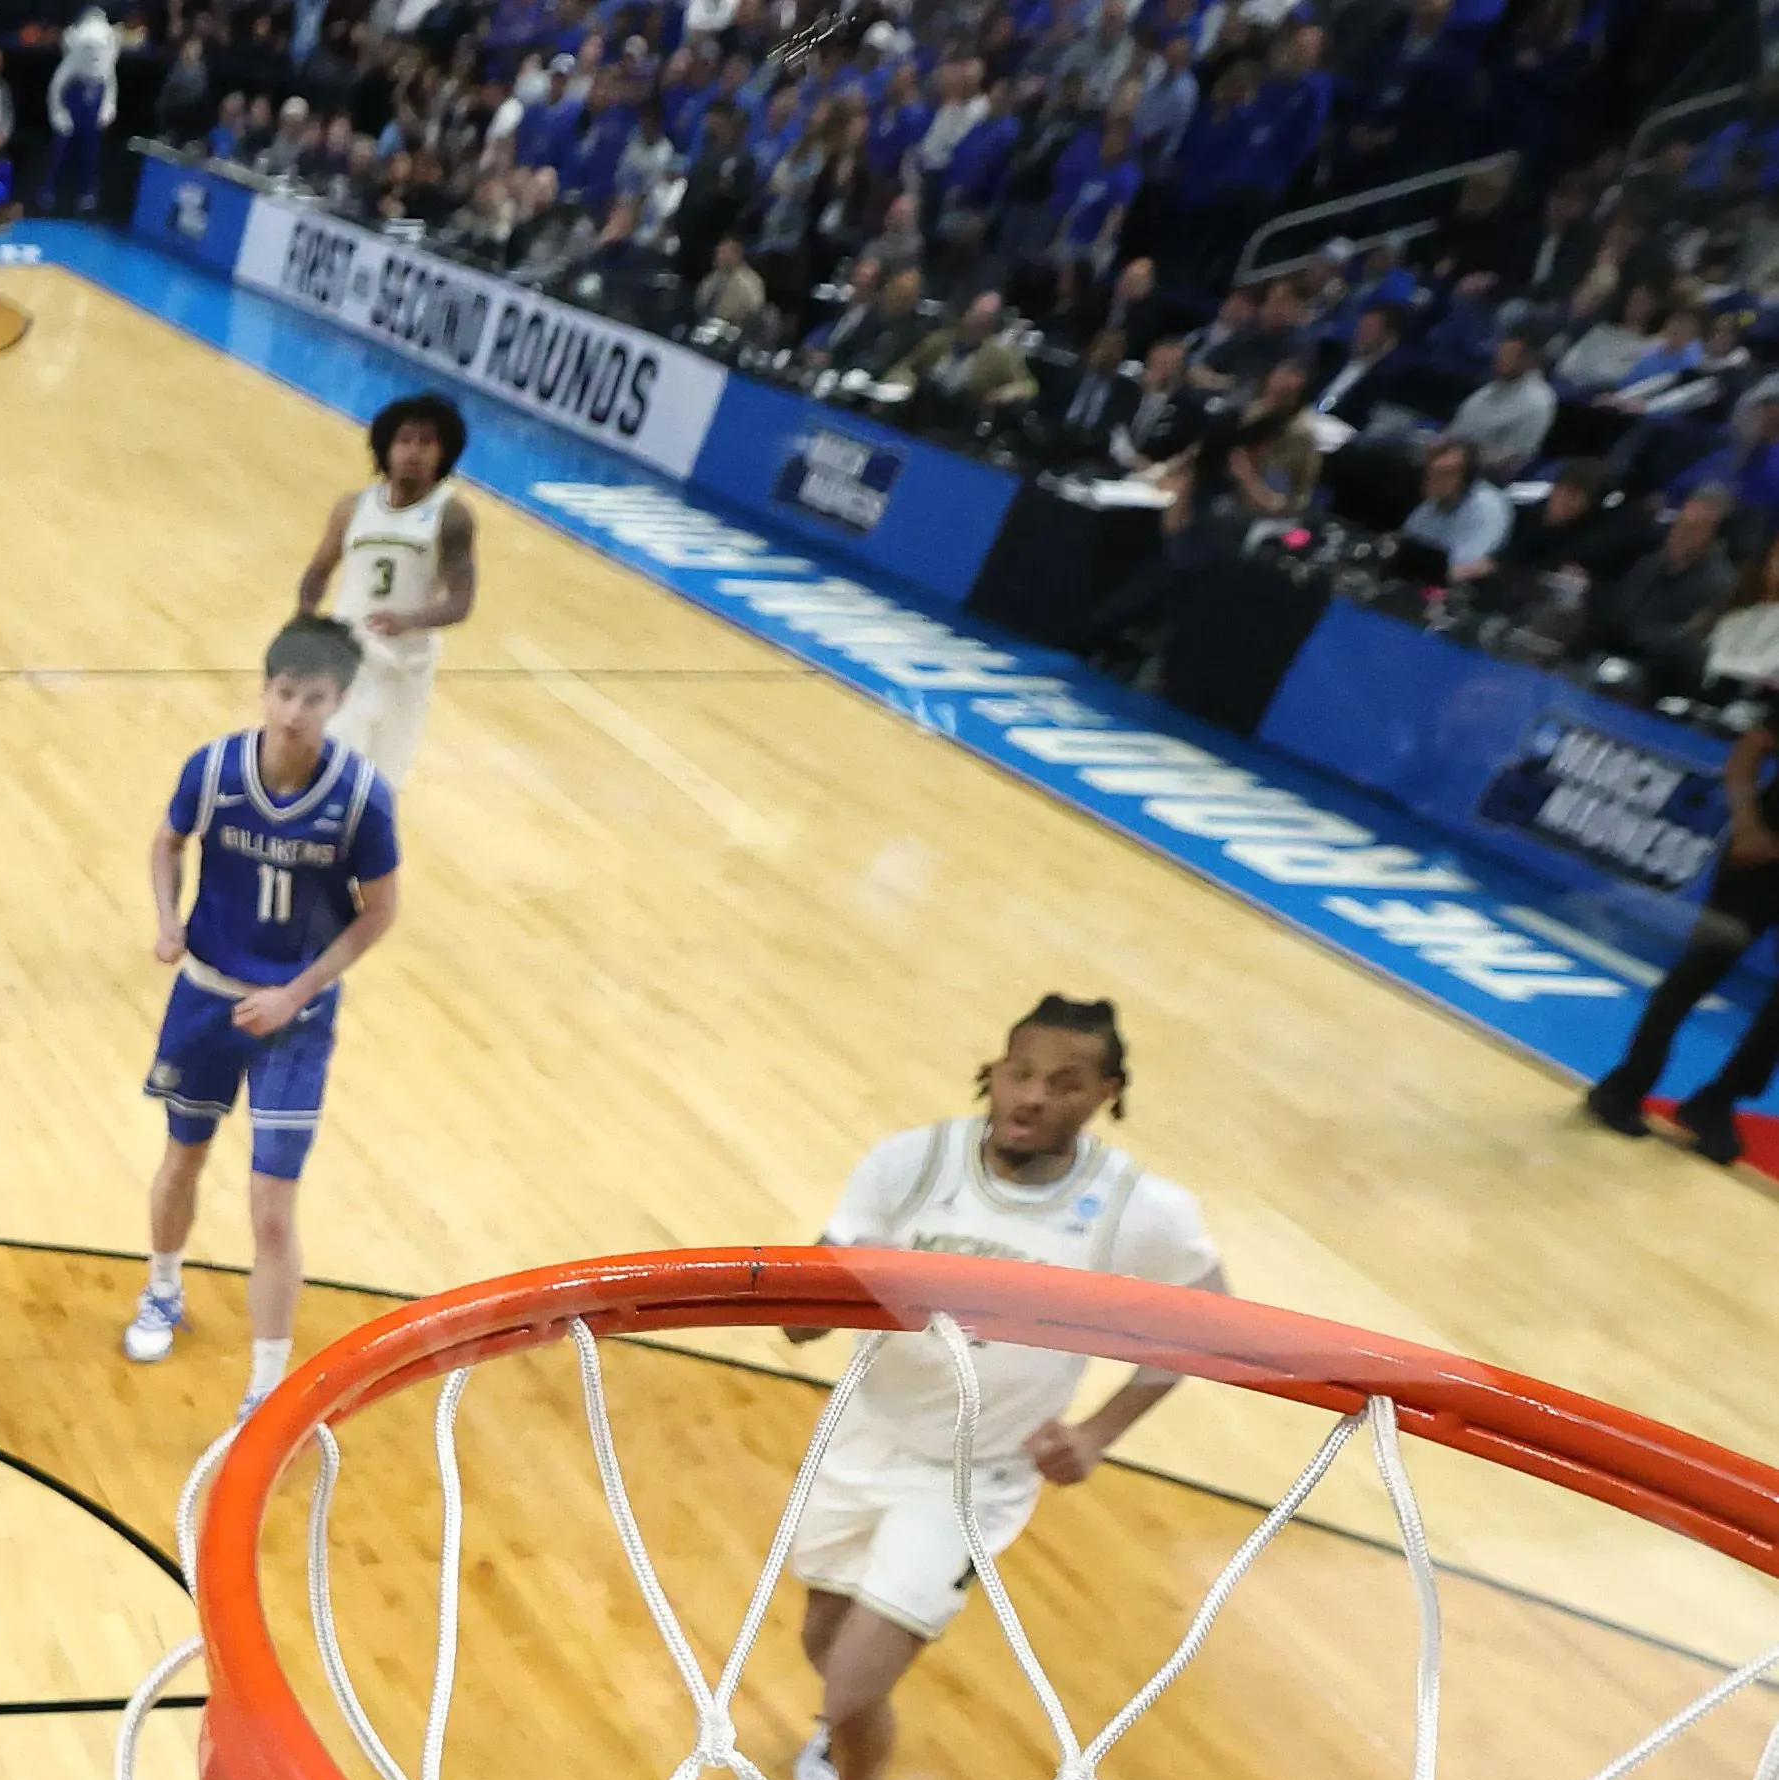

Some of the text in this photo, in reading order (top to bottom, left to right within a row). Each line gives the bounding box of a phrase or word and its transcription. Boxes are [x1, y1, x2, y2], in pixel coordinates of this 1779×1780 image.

[484, 304, 661, 438] ROUNDS
[372, 557, 396, 598] 3
[257, 863, 293, 925] 11
